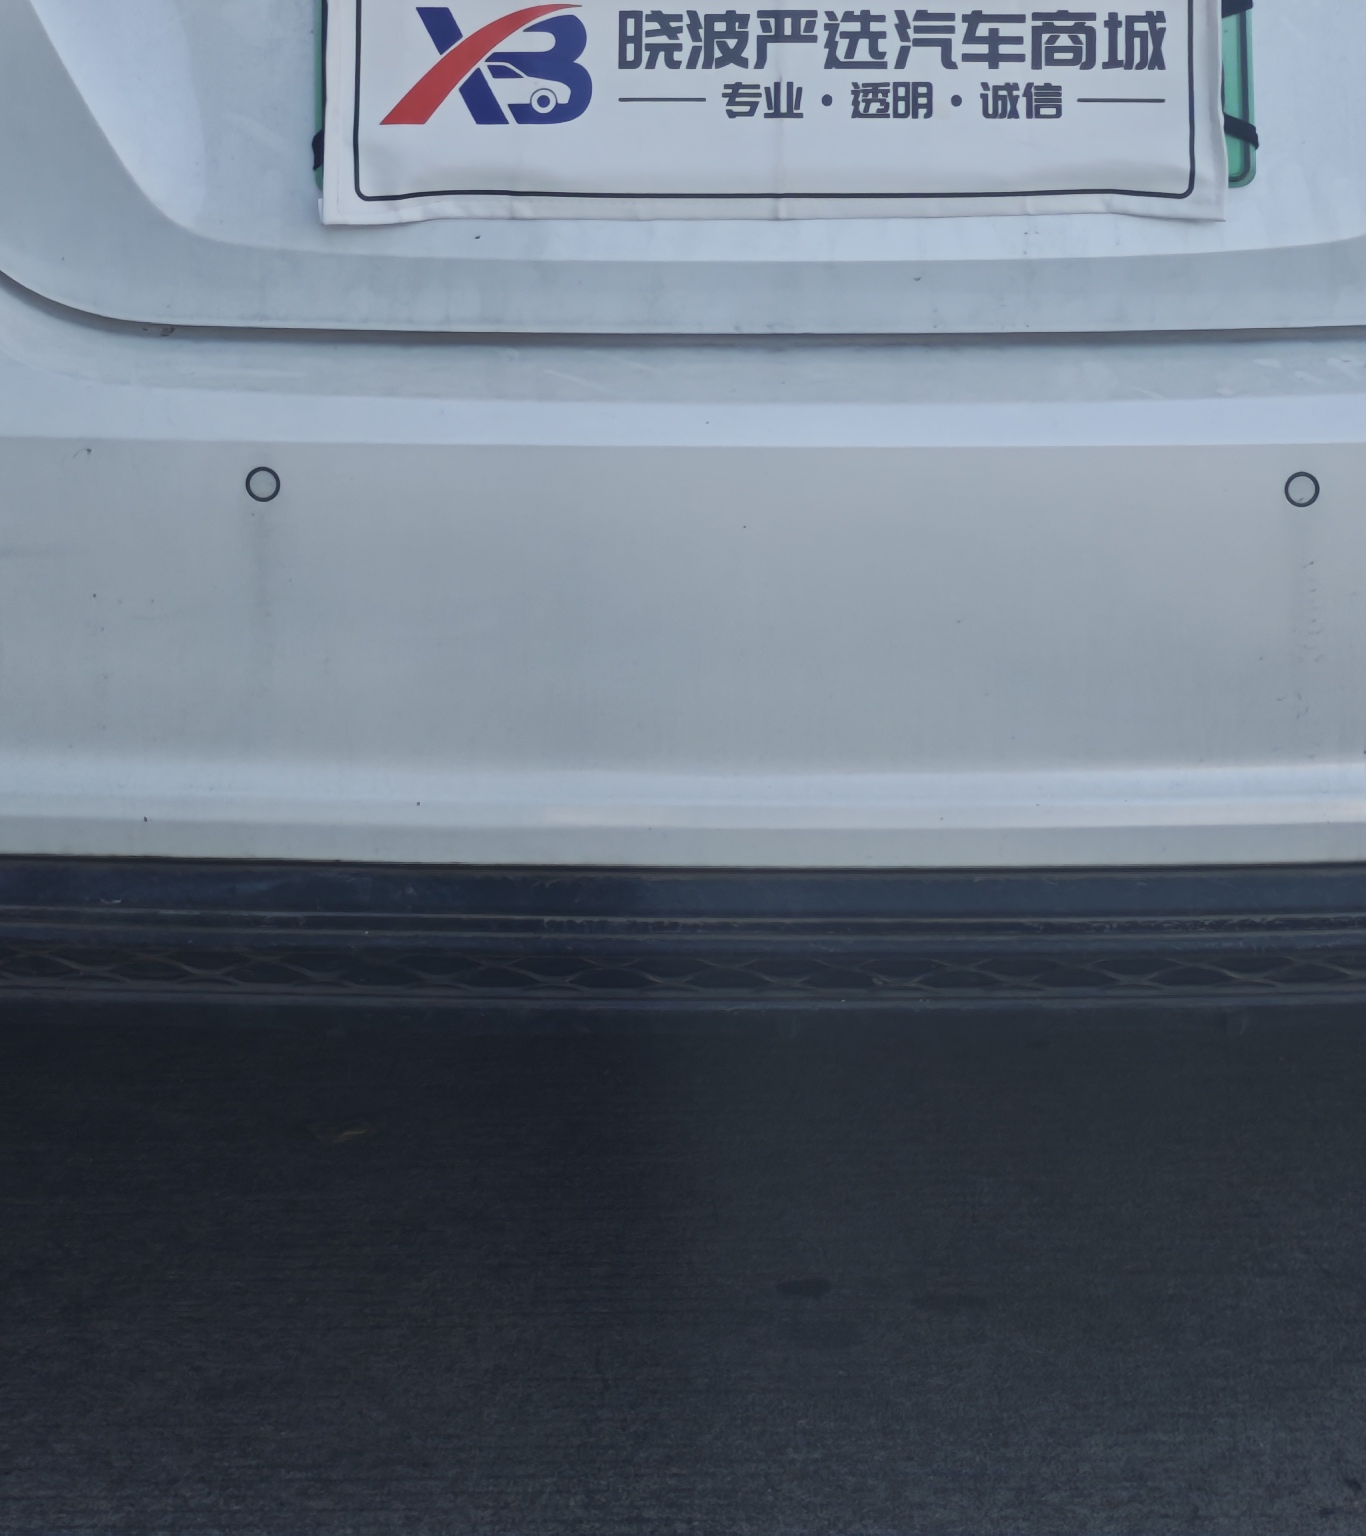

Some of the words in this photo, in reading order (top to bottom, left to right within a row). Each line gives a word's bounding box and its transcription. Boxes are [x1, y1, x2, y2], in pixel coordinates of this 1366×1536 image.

[618, 10, 1167, 70] 晓波严选汽车商城
